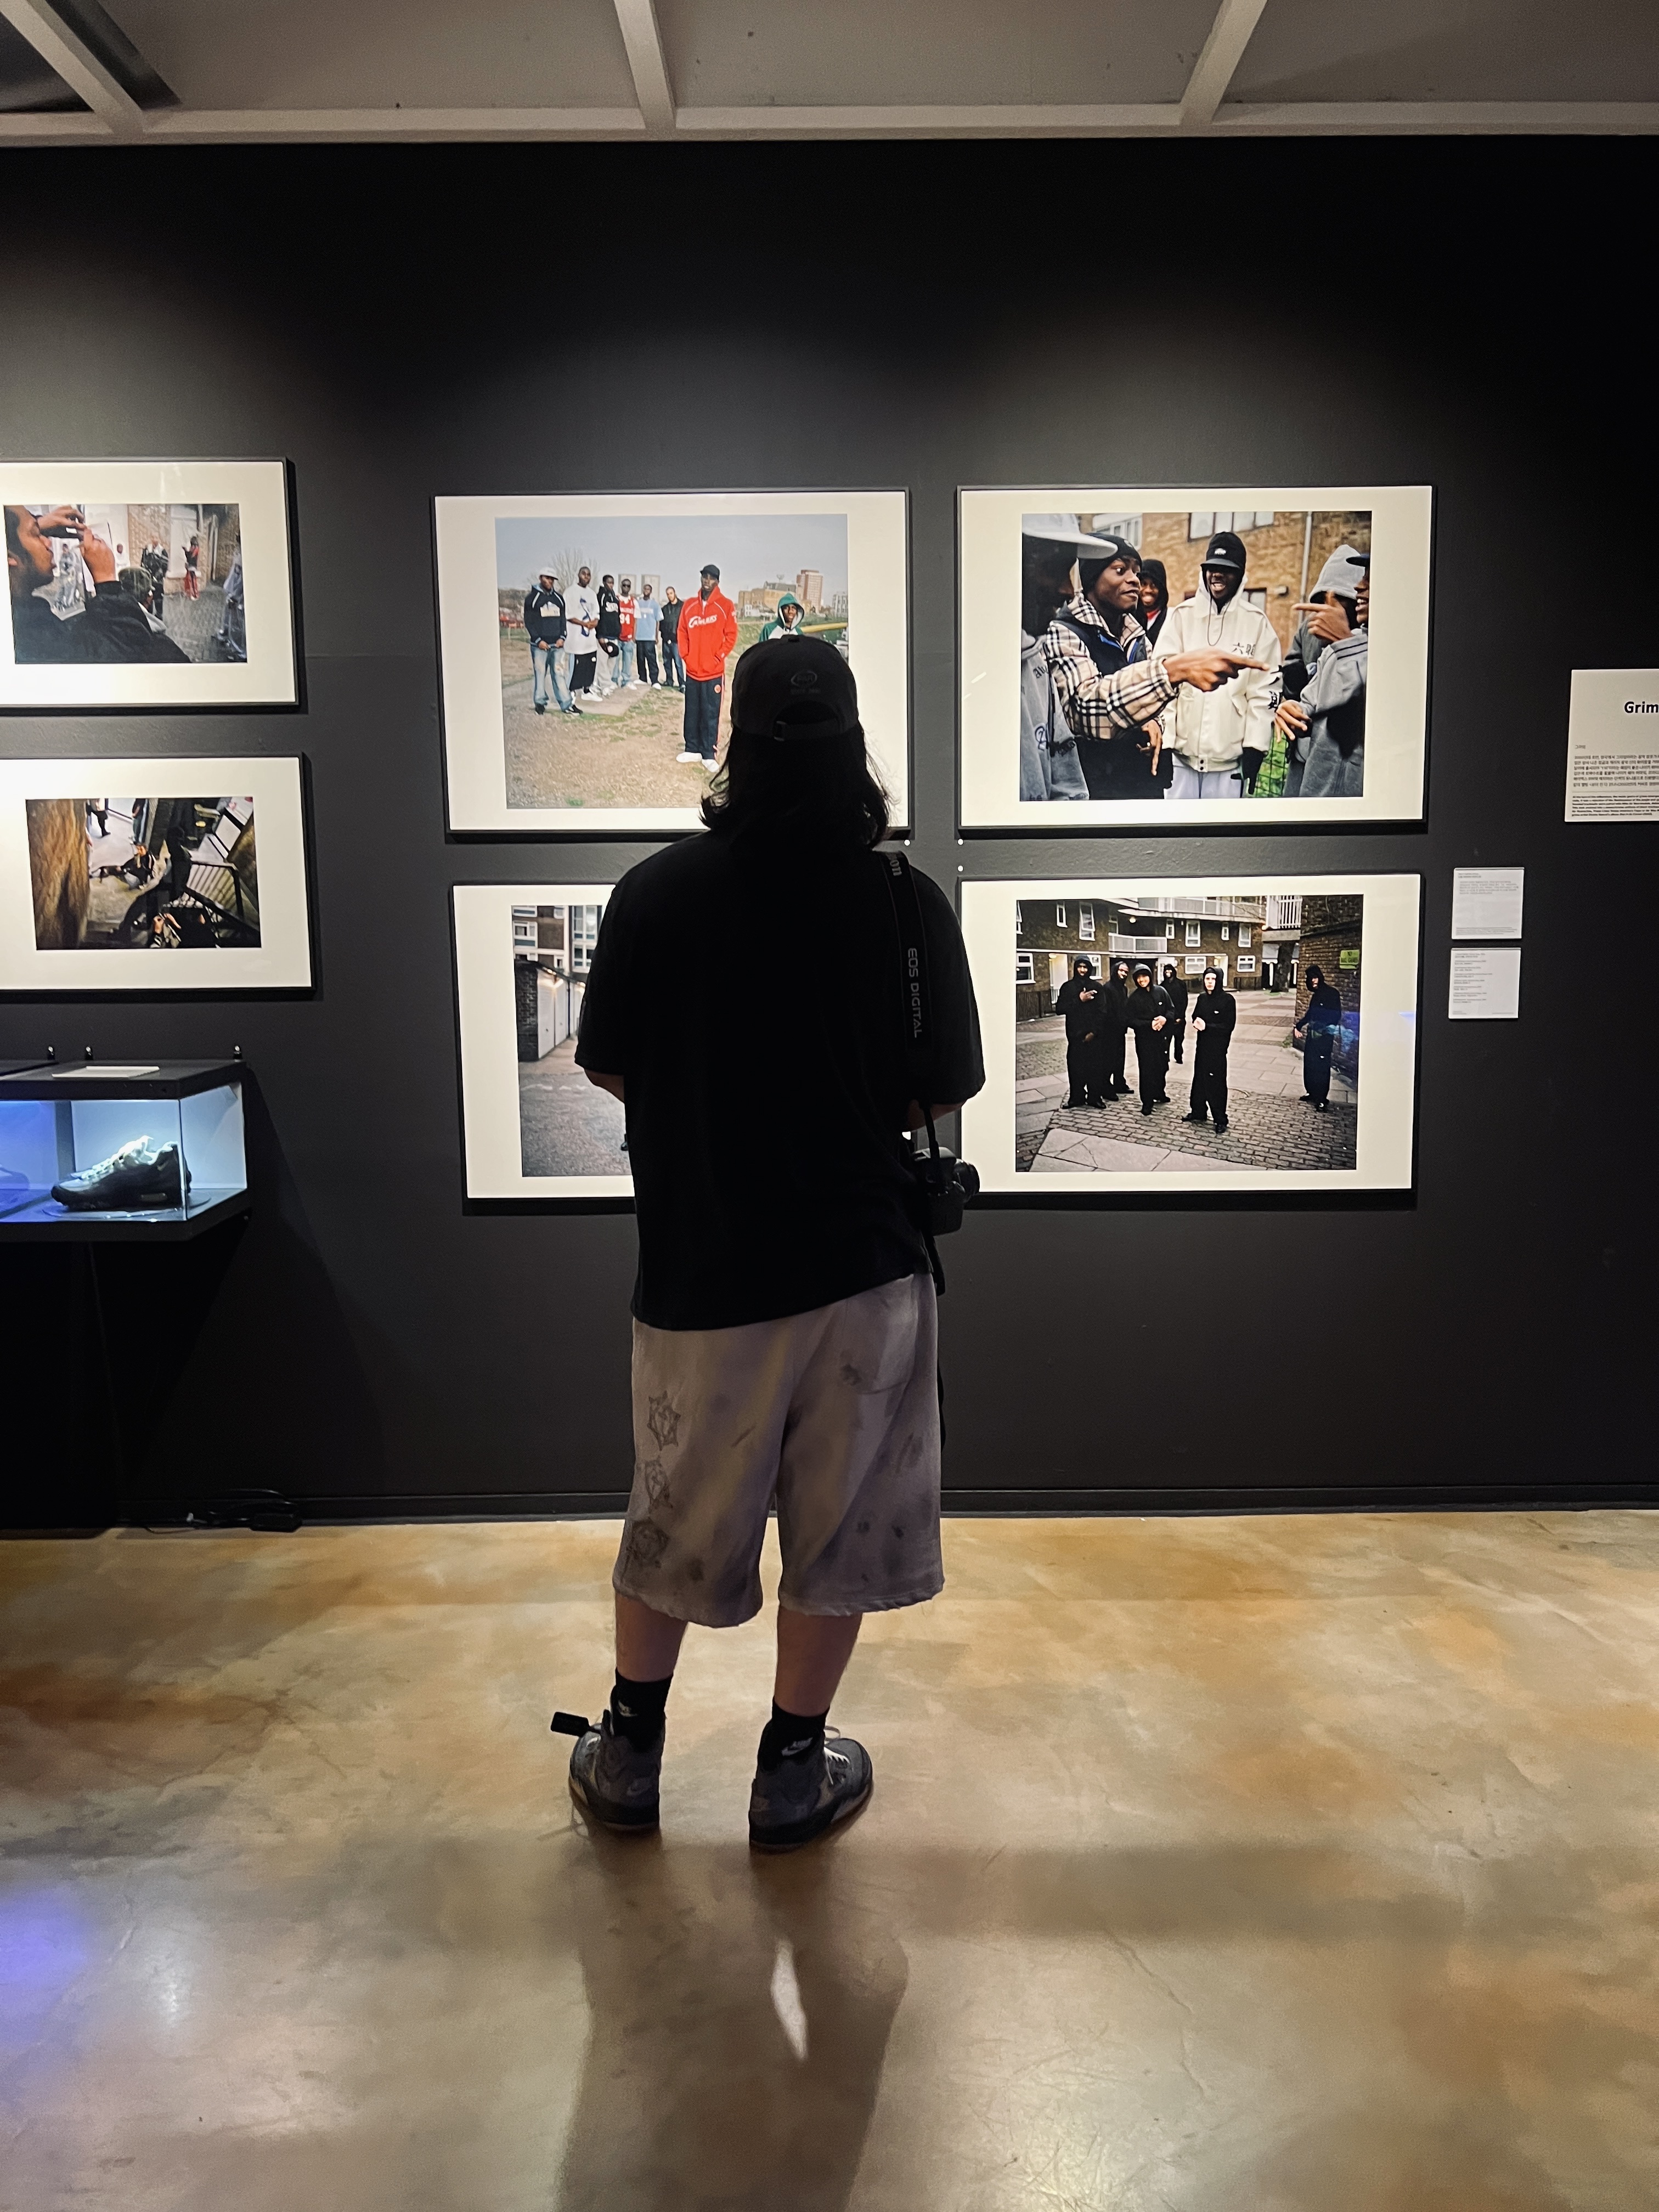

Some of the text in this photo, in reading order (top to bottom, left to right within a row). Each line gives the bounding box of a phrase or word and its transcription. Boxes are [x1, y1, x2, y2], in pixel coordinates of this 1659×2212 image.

[1624, 701, 1658, 713] Grim
[908, 948, 922, 1038] EOS DIGITAL
